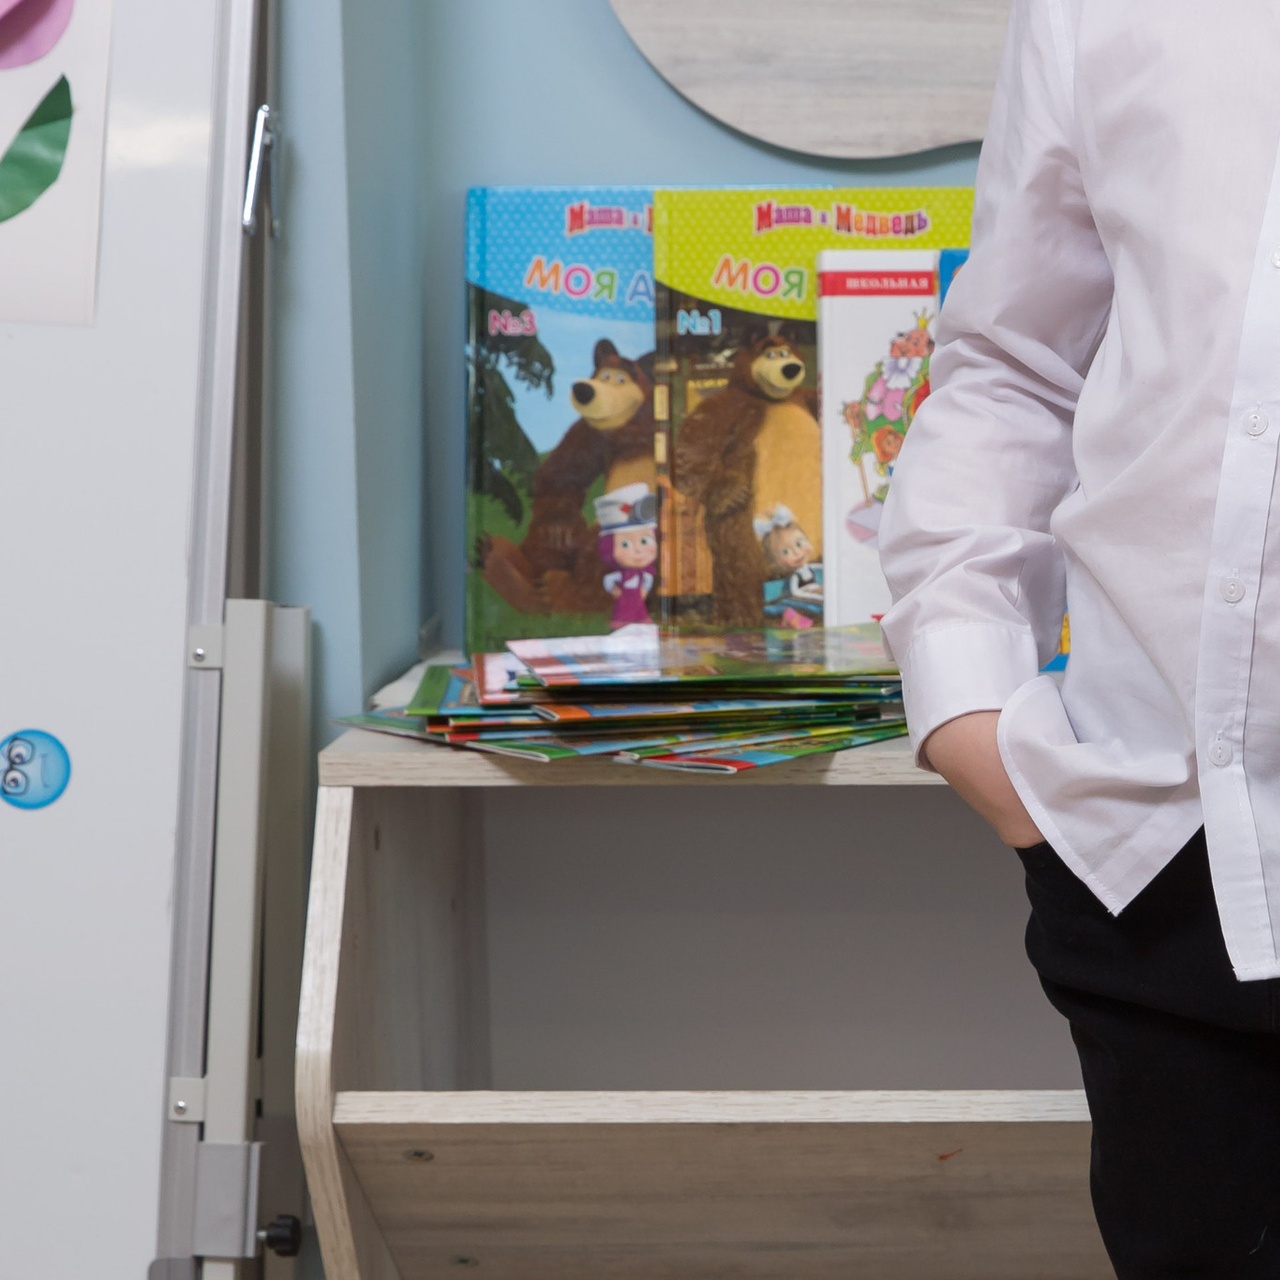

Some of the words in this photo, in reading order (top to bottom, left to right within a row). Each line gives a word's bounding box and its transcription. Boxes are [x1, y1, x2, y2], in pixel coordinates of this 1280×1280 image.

[755, 200, 813, 235] Маша
[835, 203, 929, 237] Медведь
[525, 257, 617, 302] МОЯ
[713, 256, 805, 300] МОЯ
[845, 277, 930, 291] ШКОЛЬНАЯ
